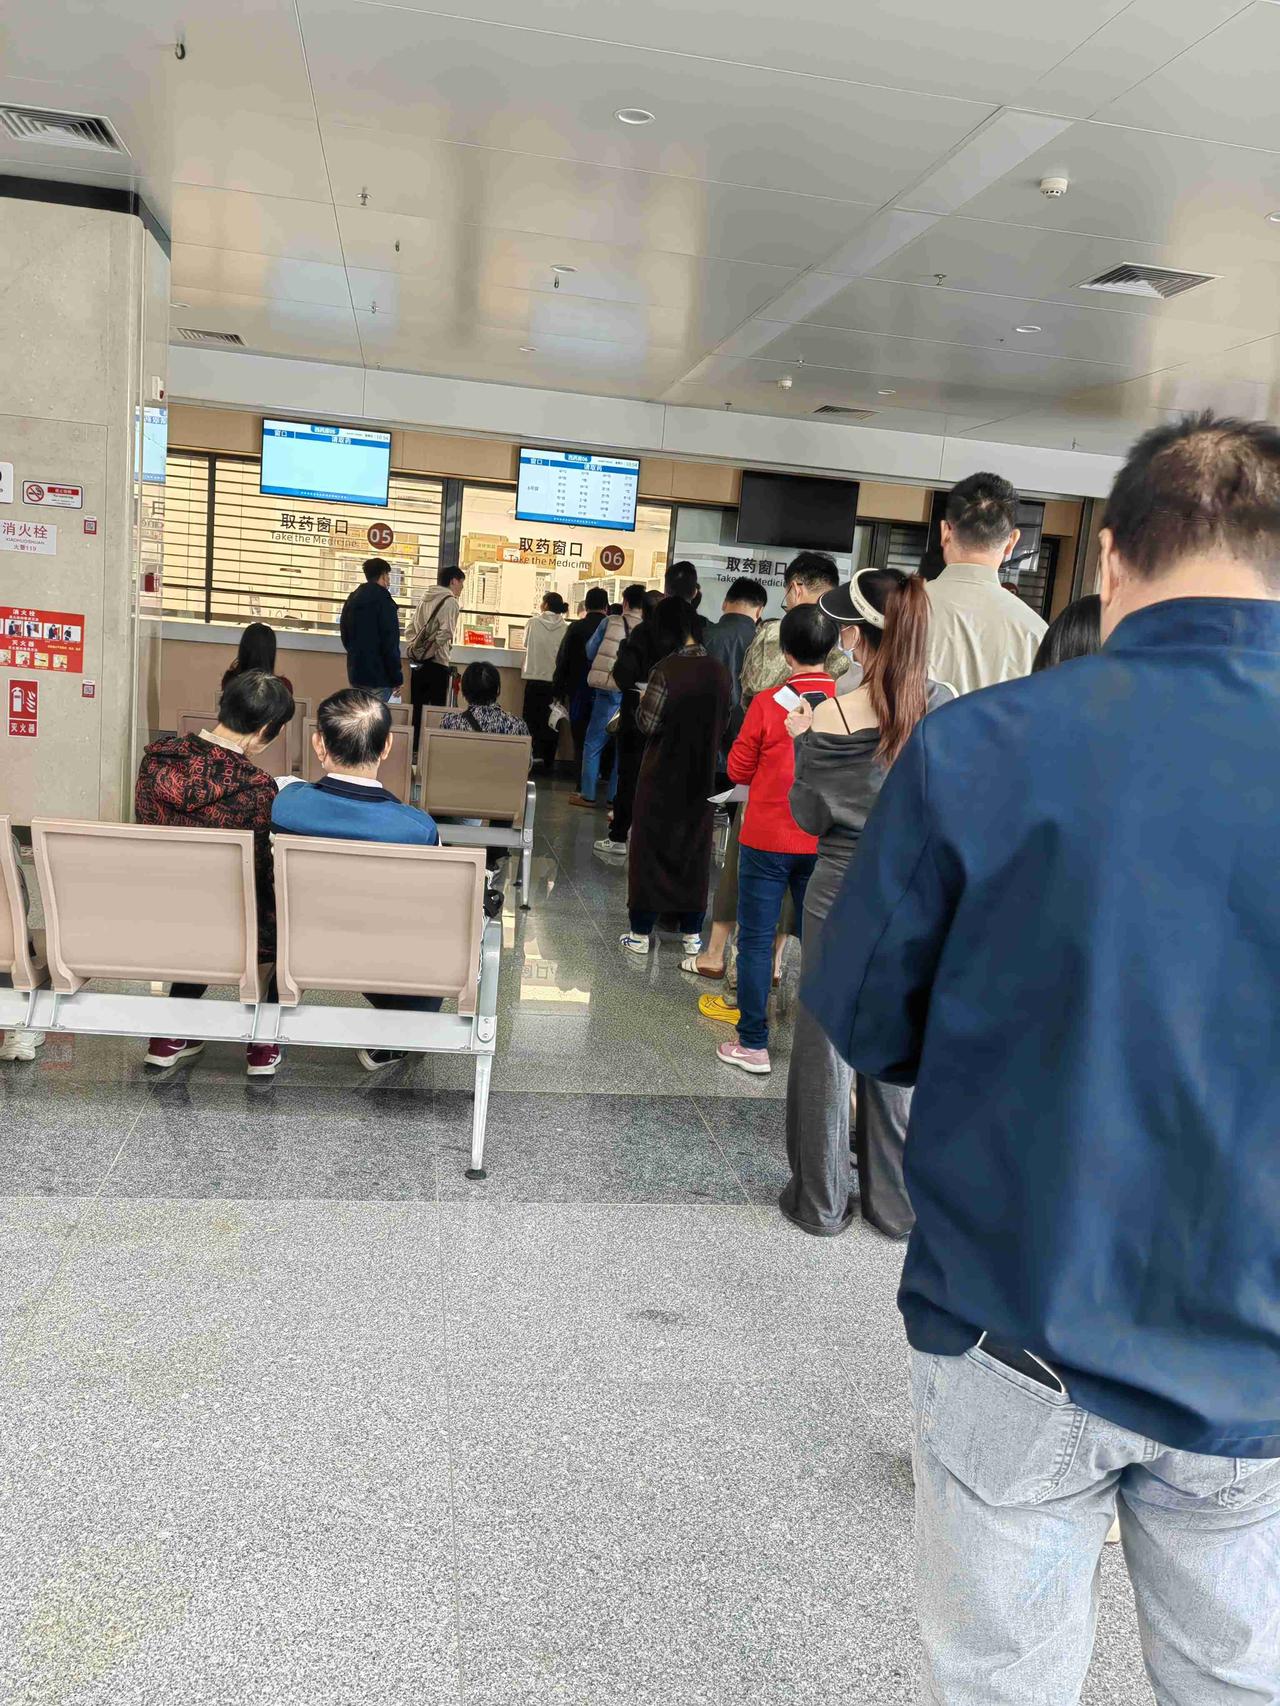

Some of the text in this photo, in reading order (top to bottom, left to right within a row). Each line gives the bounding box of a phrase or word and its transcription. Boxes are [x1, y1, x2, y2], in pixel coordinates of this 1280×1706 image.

[2, 522, 48, 539] 消火栓
[280, 513, 348, 535] 取药窗口
[271, 531, 357, 548] Take the Medicine
[369, 528, 391, 544] 05
[518, 537, 583, 557] 取药窗口
[508, 554, 590, 570] Take the Medicine
[601, 550, 623, 566] 06
[725, 556, 787, 576] 取药窗口
[716, 573, 737, 583] Take
[10, 722, 36, 734] 灭火器
